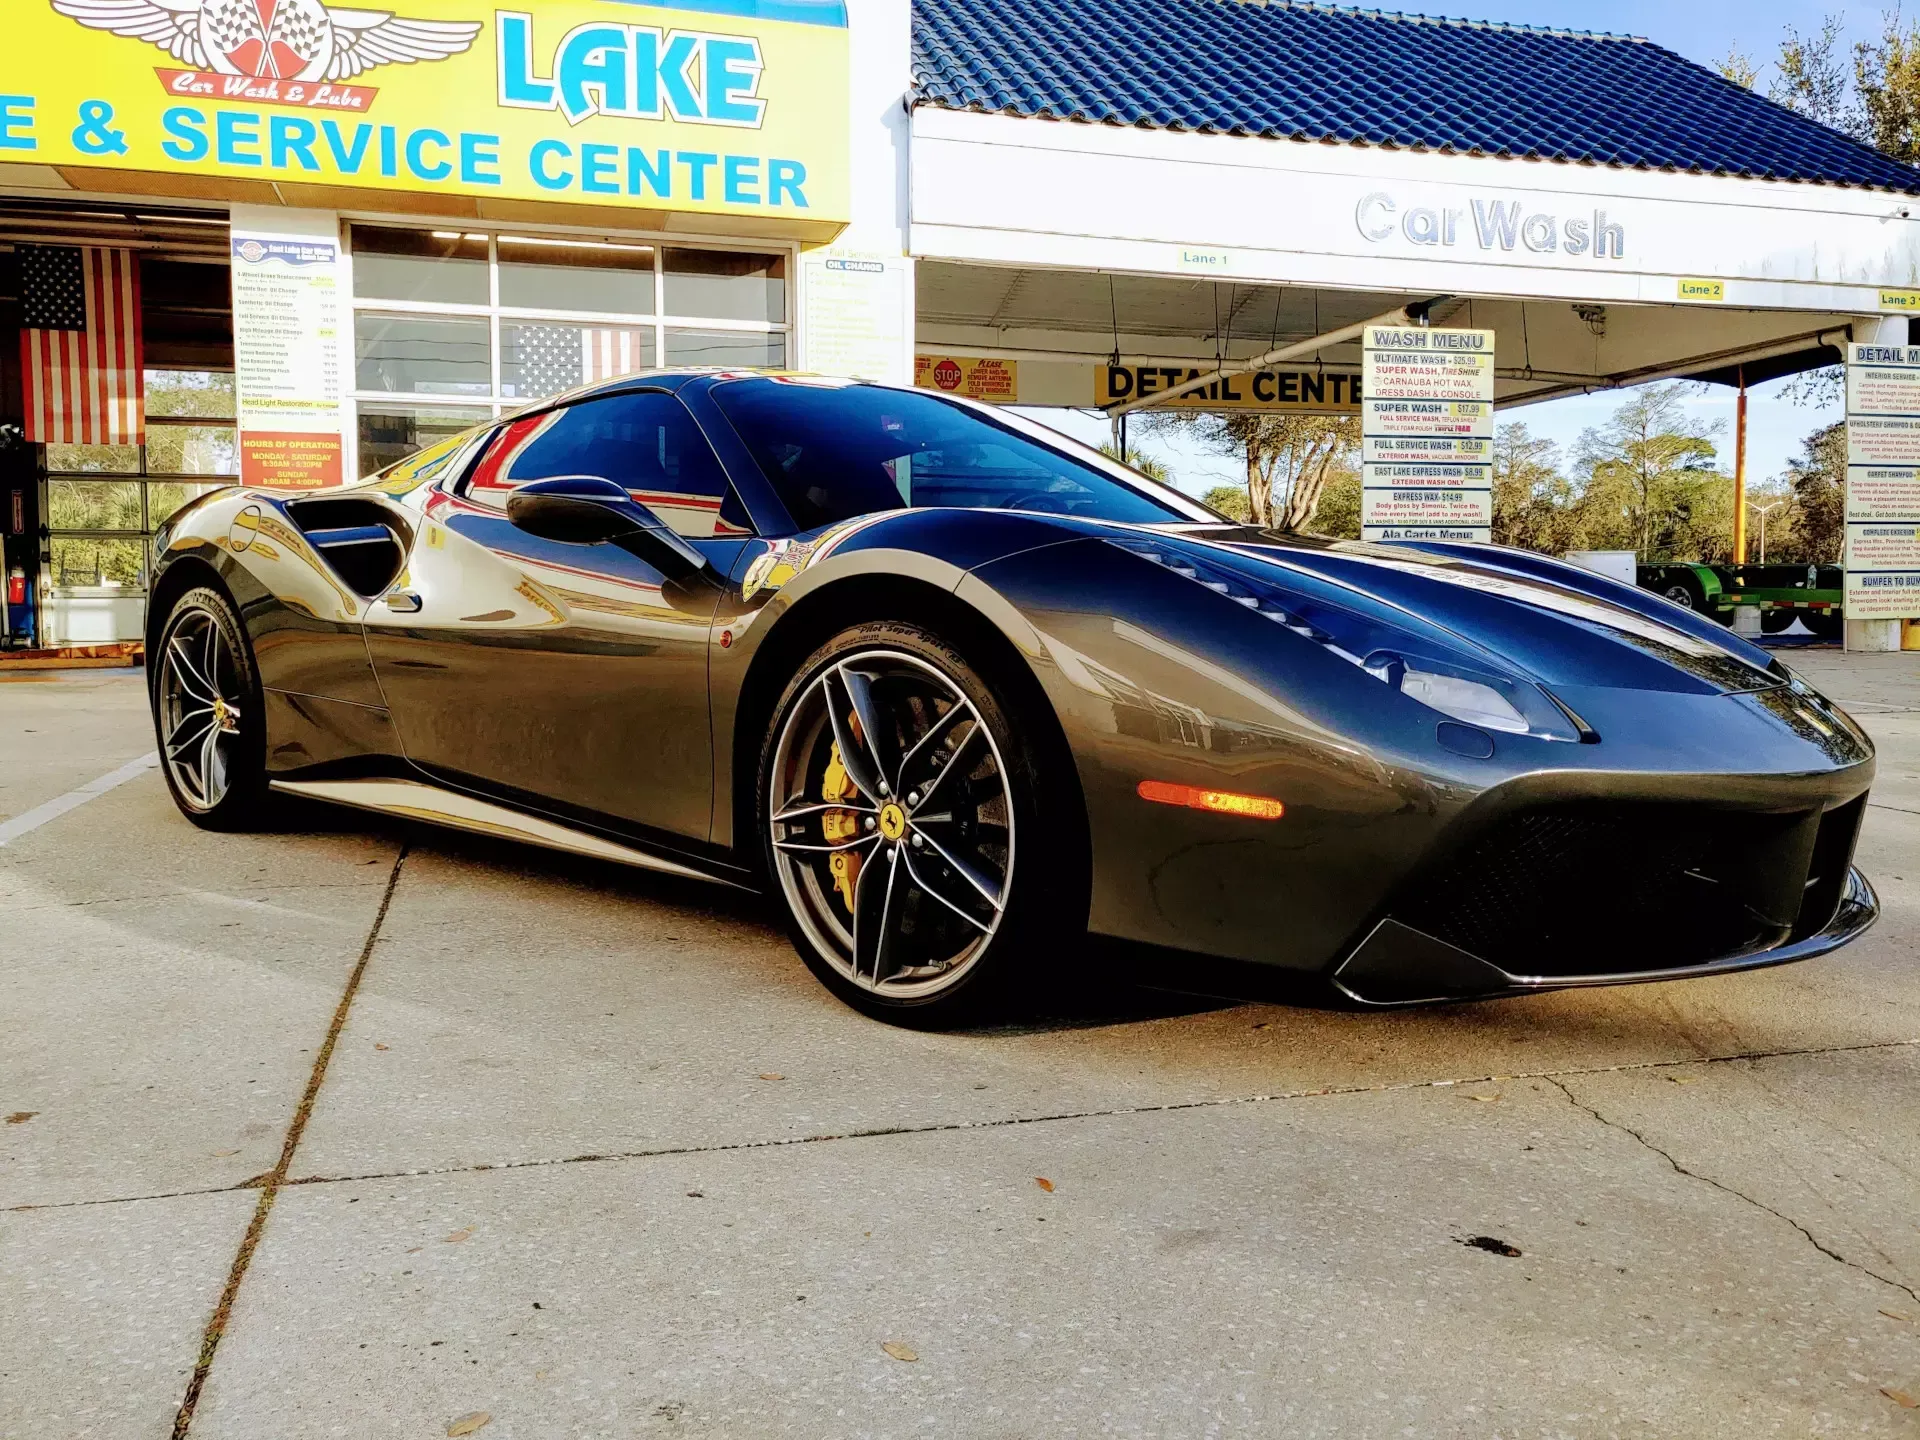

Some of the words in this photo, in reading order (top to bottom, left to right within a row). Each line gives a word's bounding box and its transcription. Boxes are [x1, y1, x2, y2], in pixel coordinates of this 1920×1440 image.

[496, 10, 767, 129] LAKE
[171, 73, 214, 94] Car
[223, 76, 280, 100] Wash
[284, 86, 305, 102] &
[308, 86, 363, 107] Lube
[71, 98, 130, 157] &
[161, 106, 501, 186] SERVICE
[529, 139, 810, 208] CENTER
[1355, 191, 1463, 246] Car
[1469, 198, 1625, 260] Wash
[1184, 251, 1216, 264] Lane
[1223, 255, 1227, 265] 1
[827, 260, 844, 270] OIL
[844, 261, 883, 272] CHANGE
[1682, 283, 1710, 295] Lane
[1713, 285, 1720, 295] 2
[1881, 294, 1907, 306] Lane
[1909, 296, 1916, 306] 3
[1373, 330, 1427, 347] WASH
[1432, 332, 1485, 350] MENU
[1374, 353, 1418, 364] ULTIMATE
[1420, 355, 1446, 365] WASH
[1453, 355, 1476, 365] $25.99
[1856, 346, 1905, 363] DETAIL
[977, 359, 1003, 368] PLEASE
[935, 369, 961, 381] STOP
[1375, 366, 1407, 375] SUPER
[1865, 371, 1891, 380] INTERIOR
[1892, 372, 1917, 381] SERVICE
[1107, 366, 1242, 401] DETAIL
[1383, 377, 1432, 387] CARNAUBA
[1433, 378, 1451, 387] HOT
[1375, 388, 1404, 397] DRESS
[1407, 389, 1431, 398] DASH
[1433, 390, 1440, 398] &
[1440, 390, 1480, 399] CONSOLE
[242, 398, 259, 406] Head
[259, 399, 276, 408] Light
[1374, 403, 1409, 412] SUPER
[1411, 404, 1442, 413] WASH
[1457, 404, 1480, 413] $17.99
[1850, 420, 1883, 428] UPHOLSTERY
[1883, 421, 1909, 429] SHAMPOO
[243, 439, 273, 448] HOURS
[275, 440, 287, 448] OF
[289, 441, 340, 450] OPERATION:
[1374, 440, 1394, 449] FULL
[1395, 441, 1428, 450] SERVICE
[1429, 441, 1452, 450] WASH
[1461, 441, 1483, 450] $12.99
[252, 452, 286, 460] MONDAY
[291, 453, 333, 461] SATURDAY
[277, 470, 309, 478] SUNDAY
[1374, 467, 1392, 476] EAST
[1393, 467, 1411, 476] LAKE
[1412, 467, 1441, 477] EXPRESS
[1464, 468, 1483, 477] $8.99
[1888, 471, 1913, 479] SHAMPOO
[1393, 492, 1423, 501] EXPRESS
[1376, 502, 1391, 510] Body
[1848, 510, 1860, 518] Best
[1875, 510, 1885, 518] Get
[1382, 530, 1400, 539] Ala
[1404, 530, 1436, 539] Carte
[1439, 531, 1473, 539] Menu:
[1862, 528, 1890, 536] COMPLETE
[1890, 528, 1915, 536] EXTERIOR
[1862, 576, 1893, 587] BUMPER
[1894, 577, 1904, 587] TO
[857, 624, 883, 634] Pilot
[883, 624, 915, 636] Super
[916, 632, 946, 651] Sport
